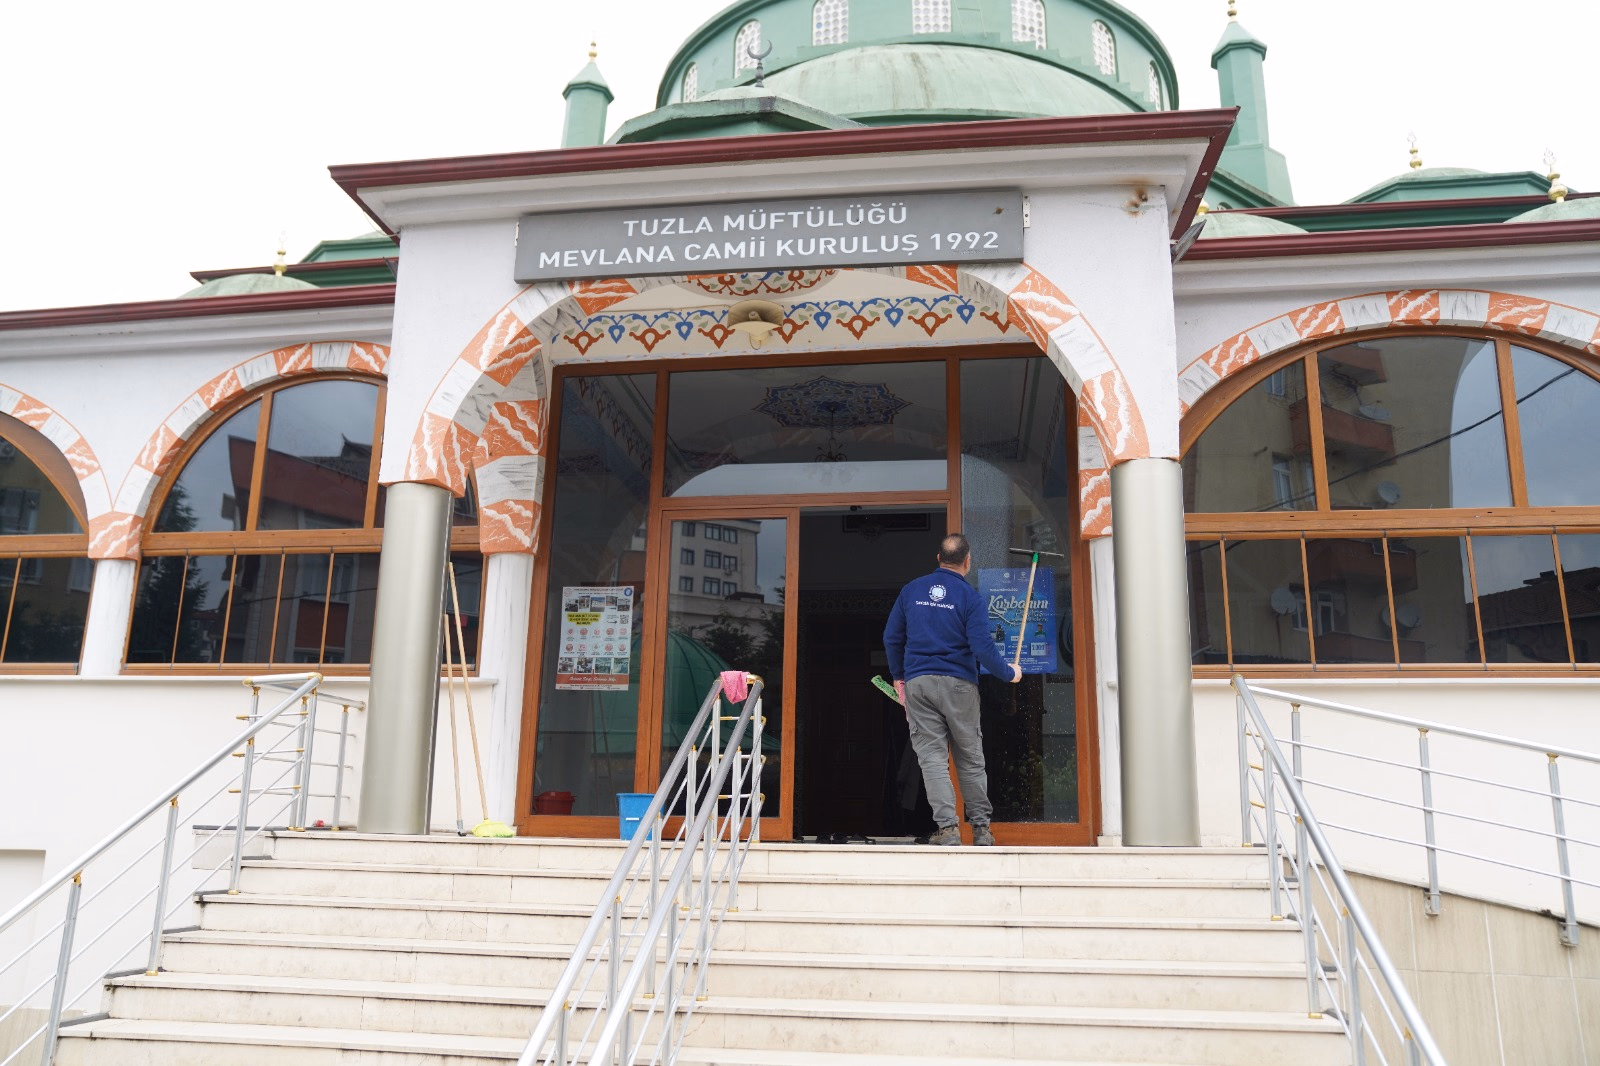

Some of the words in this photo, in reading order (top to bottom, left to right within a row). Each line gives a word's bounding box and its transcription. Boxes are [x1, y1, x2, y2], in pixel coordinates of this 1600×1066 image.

[623, 216, 714, 237] TUZLA
[723, 202, 908, 232] MÜFTÜLÜĞÜ
[538, 245, 676, 269] MEVLANA
[684, 236, 766, 261] CAMİİ
[776, 233, 920, 257] KURULUŞ
[930, 231, 1000, 251] 1992
